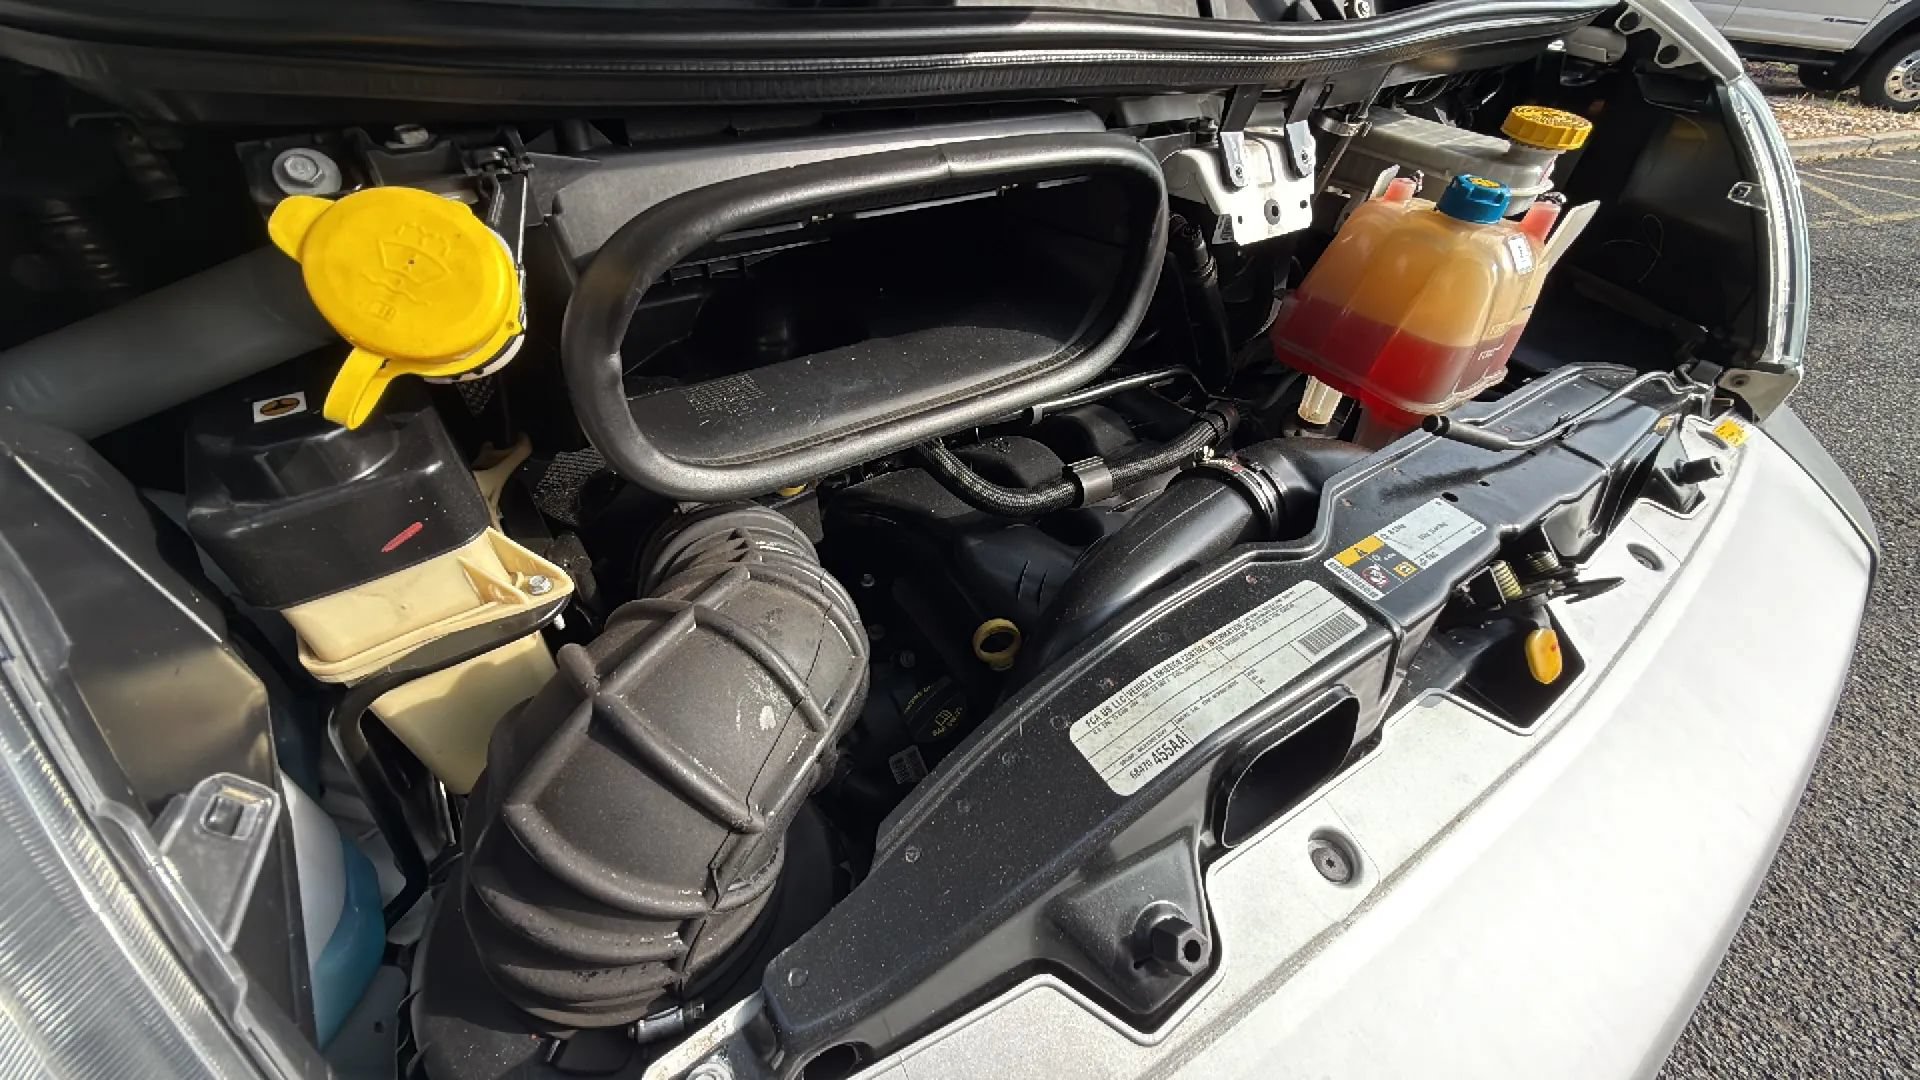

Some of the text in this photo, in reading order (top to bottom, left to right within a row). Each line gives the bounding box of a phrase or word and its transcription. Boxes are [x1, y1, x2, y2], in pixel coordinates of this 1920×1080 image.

[1127, 675, 1154, 698] VEHICLE
[1084, 713, 1103, 728] FCA
[1100, 705, 1113, 717] US
[1111, 695, 1127, 709] LLC
[1151, 733, 1189, 766] 455AA
